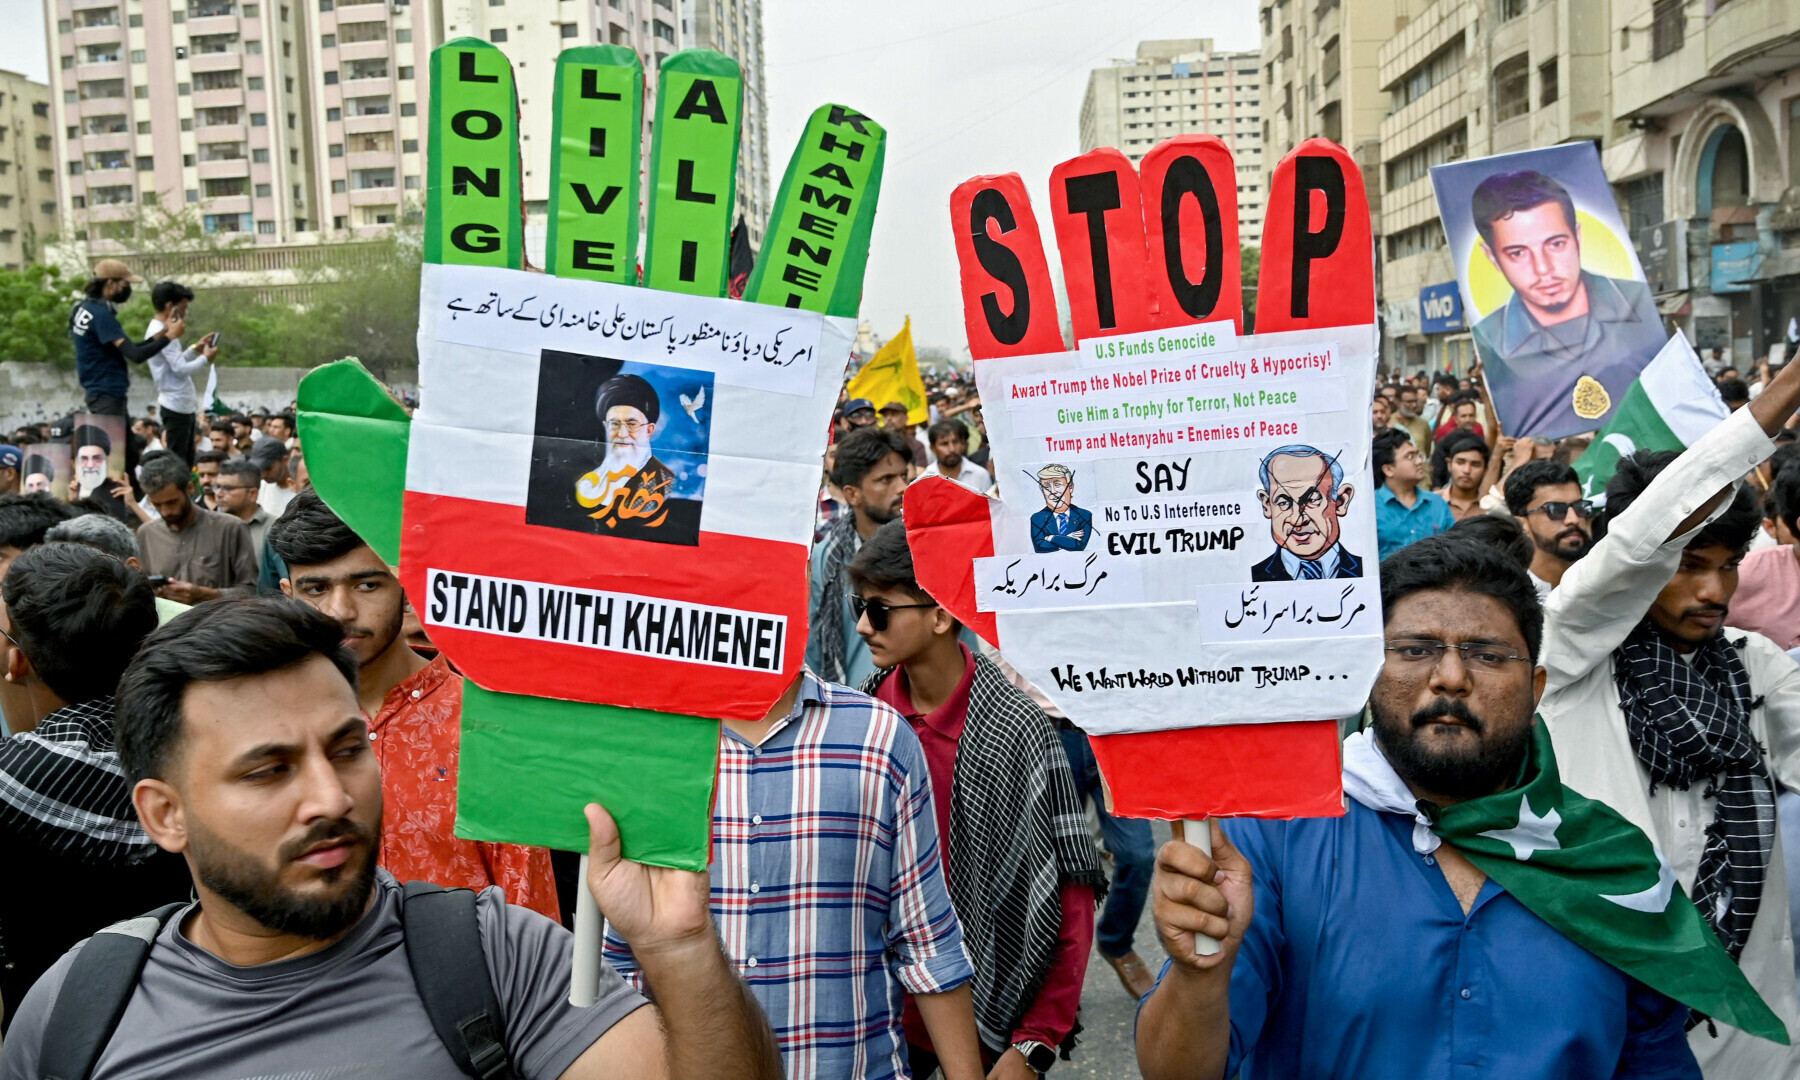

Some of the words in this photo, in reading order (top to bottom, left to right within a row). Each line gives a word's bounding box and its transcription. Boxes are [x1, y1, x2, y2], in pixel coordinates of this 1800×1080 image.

[451, 52, 503, 254] LONG
[570, 69, 623, 272] LIVE
[673, 79, 728, 283] ALI
[785, 105, 872, 309] KHAMENEI
[970, 156, 1346, 345] STOP
[447, 297, 472, 320] ہے
[474, 292, 513, 318] ساتھ
[512, 295, 538, 321] کے
[602, 303, 626, 337] علی
[621, 316, 676, 354] پاکستان
[763, 327, 813, 367] امریکی
[1095, 342, 1116, 360] U.S
[1119, 338, 1155, 357] Funds
[1158, 331, 1216, 352] Genocide
[1011, 381, 1047, 399] Award
[1050, 379, 1087, 396] Trump
[1090, 375, 1110, 391] the
[1113, 370, 1147, 388] Nobel
[1150, 367, 1181, 385] Prize
[1185, 364, 1197, 381] of
[1201, 360, 1246, 379] Cruelty
[1250, 358, 1260, 374] &
[1263, 350, 1332, 376] Hypocrisy!
[1057, 408, 1083, 425] Give
[1086, 405, 1109, 422] Him
[1112, 407, 1120, 419] a
[1122, 401, 1163, 420] Trophy
[1167, 398, 1184, 414] for
[1187, 396, 1230, 413] Terror,
[1233, 392, 1256, 408] Not
[1259, 390, 1297, 406] Peace
[1045, 437, 1082, 454] Trump
[1086, 433, 1106, 449] and
[1109, 429, 1174, 449] Netanyahu
[1177, 430, 1184, 440] =
[1187, 424, 1240, 442] Enemies
[1243, 421, 1256, 438] of
[1259, 421, 1298, 437] Peace
[1135, 457, 1192, 495] SAY
[1105, 506, 1121, 522] No
[1123, 505, 1138, 522] To
[1141, 504, 1162, 521] U.S
[1164, 501, 1241, 519] Interference
[1107, 532, 1161, 556] EVIL
[1165, 526, 1245, 553] TRUMP
[1064, 552, 1107, 596] مرگ
[431, 572, 527, 634] STAND
[538, 588, 614, 647] WITH
[622, 600, 784, 671] KHAMENEI
[1317, 583, 1366, 629] مرگ
[1050, 664, 1083, 692] WE
[1086, 667, 1127, 691] WANT
[1128, 668, 1174, 690] WORLD
